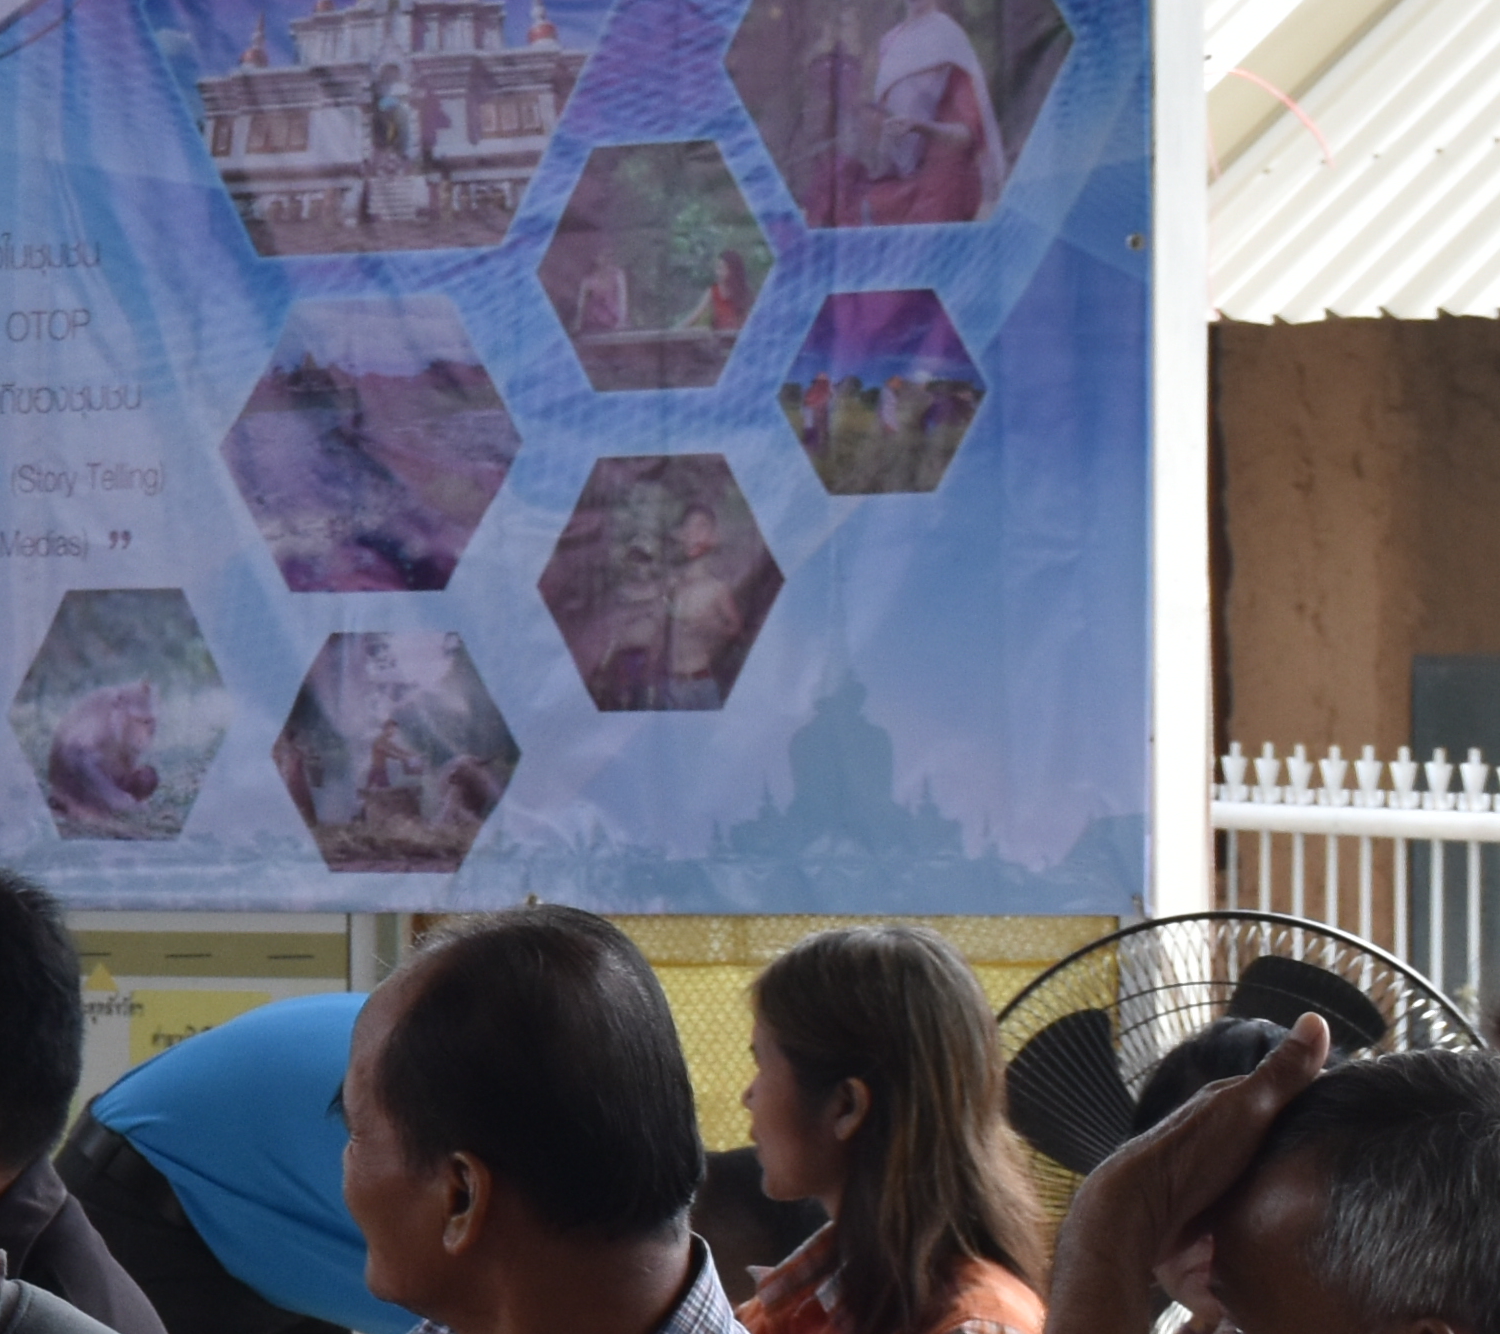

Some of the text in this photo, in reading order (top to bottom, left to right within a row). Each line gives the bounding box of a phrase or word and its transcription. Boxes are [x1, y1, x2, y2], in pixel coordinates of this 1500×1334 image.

[7, 308, 93, 343] OTOP
[10, 467, 79, 499] (Story
[86, 463, 167, 497] Telling)
